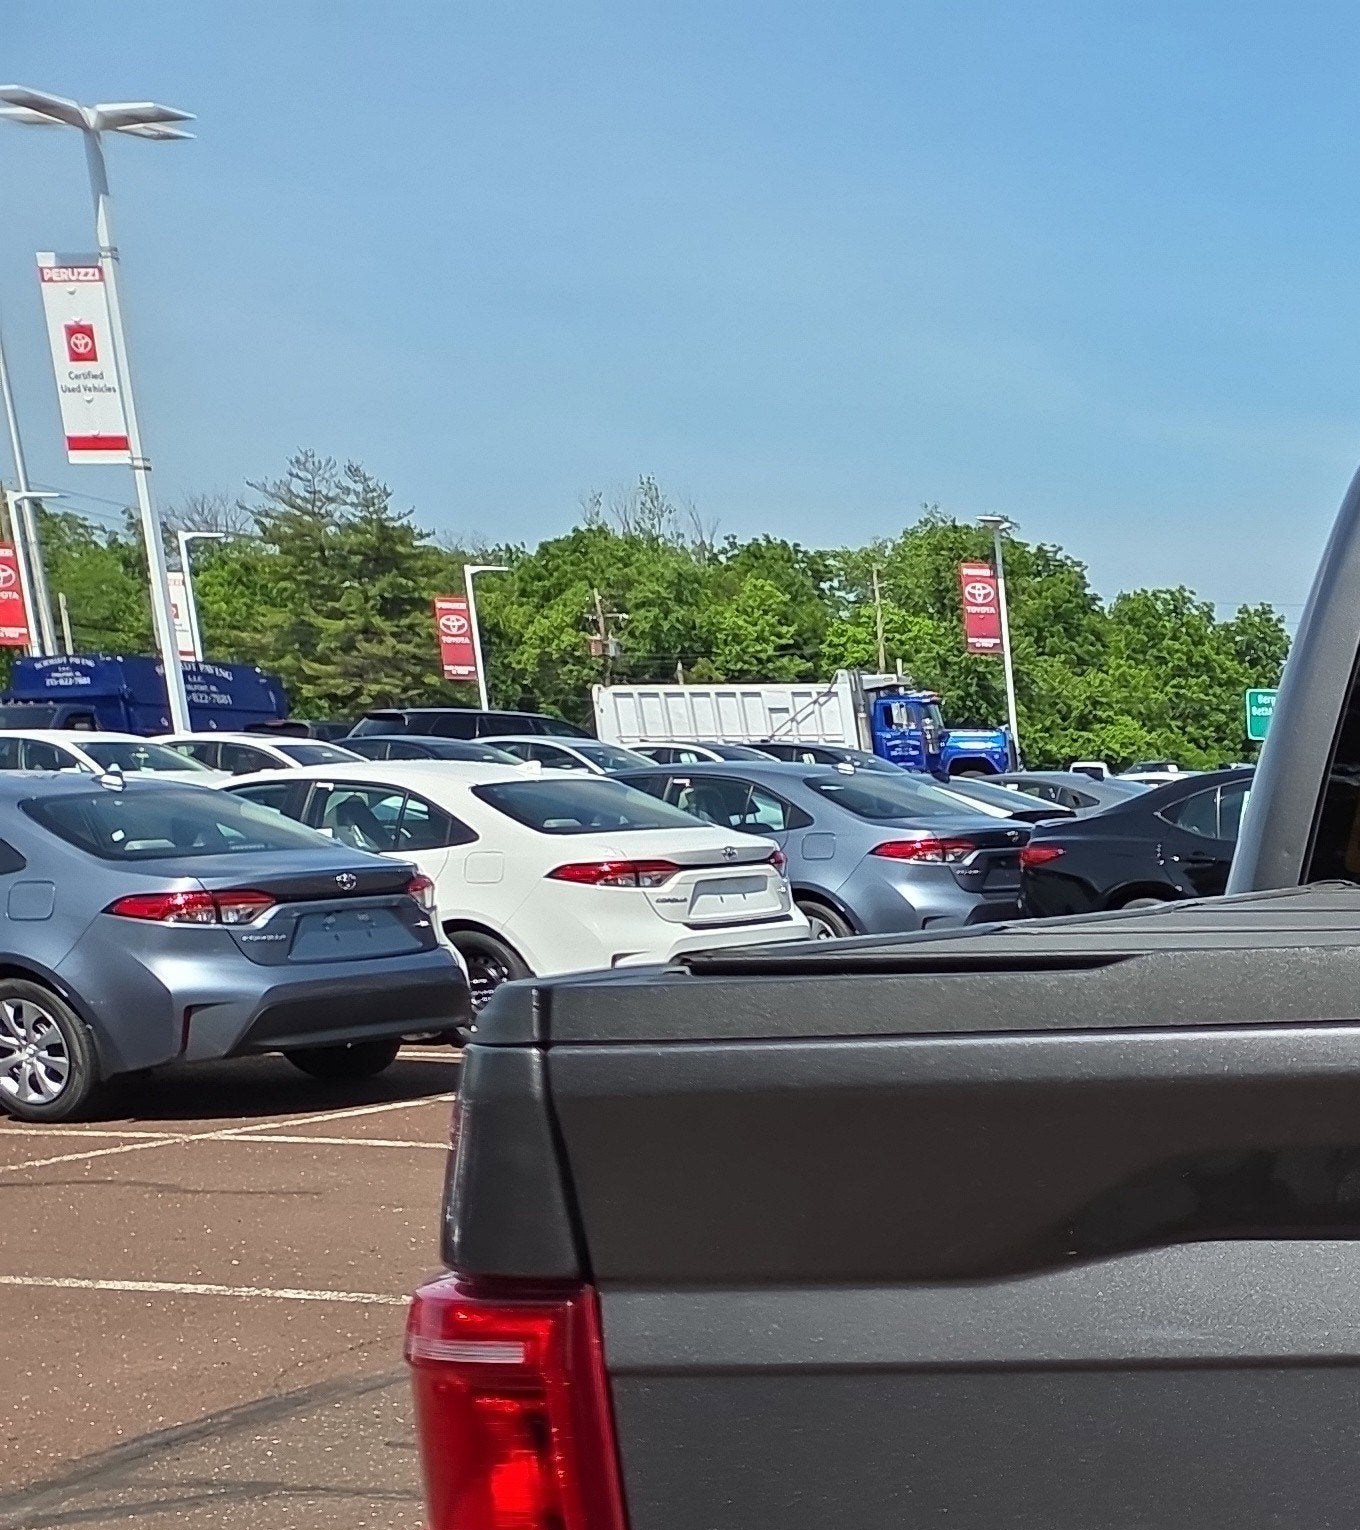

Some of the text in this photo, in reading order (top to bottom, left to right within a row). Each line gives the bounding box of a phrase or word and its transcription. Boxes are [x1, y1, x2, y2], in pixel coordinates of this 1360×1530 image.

[43, 268, 99, 280] PERUZZI
[68, 371, 104, 380] Certified
[60, 384, 116, 393] Used Vehicles
